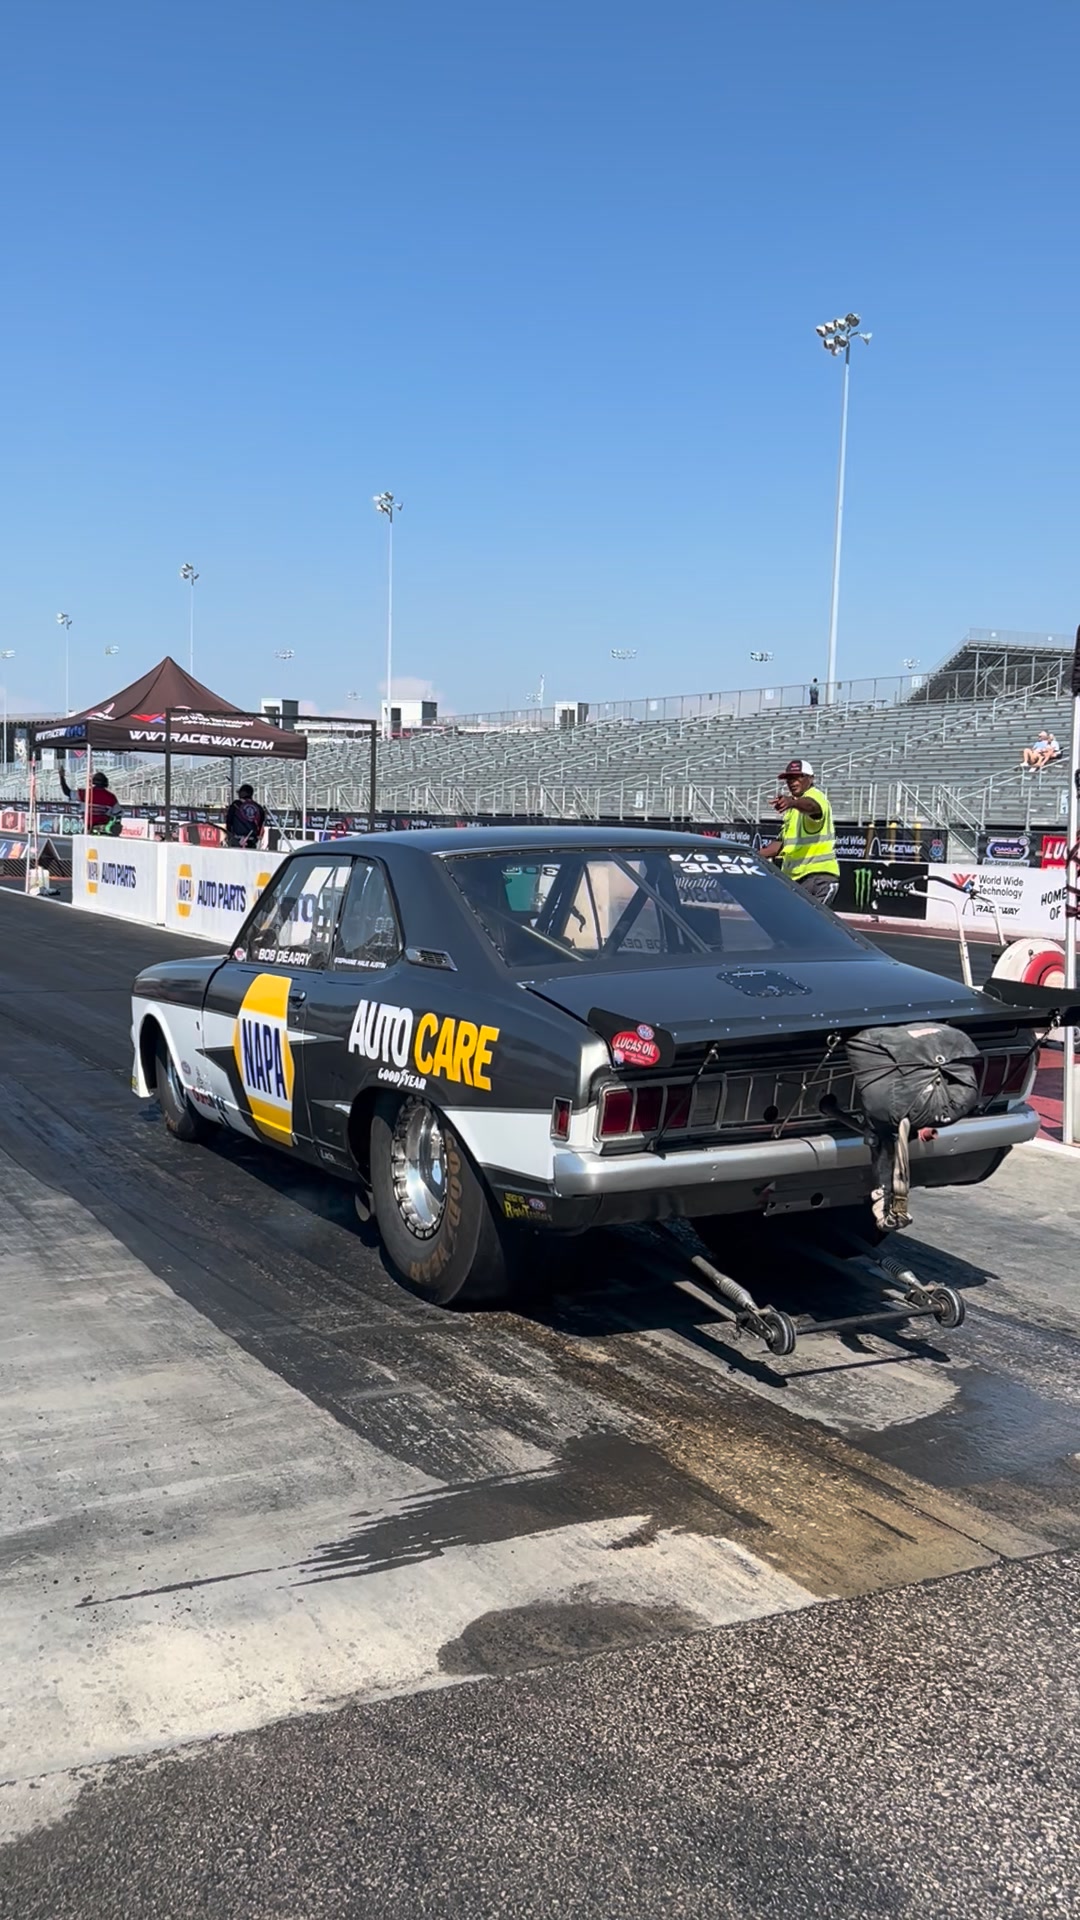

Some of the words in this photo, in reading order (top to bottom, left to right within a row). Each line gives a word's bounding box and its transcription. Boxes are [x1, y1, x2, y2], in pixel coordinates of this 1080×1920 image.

[850, 836, 866, 845] Wide
[881, 844, 922, 854] RACEWAY
[101, 861, 116, 886] AUTO
[117, 863, 136, 888] PARTS
[680, 863, 767, 876] 303K
[178, 878, 194, 902] NAPA
[979, 875, 1001, 885] World
[1003, 876, 1024, 887] Wide
[197, 879, 217, 906] AUTO
[218, 882, 246, 912] PARTS
[979, 886, 1023, 899] Technology
[1041, 888, 1067, 905] HOME
[1050, 906, 1061, 920] OF
[258, 948, 275, 960] BOB
[277, 950, 311, 966] DEARRY
[348, 999, 413, 1068] AUTO
[414, 1012, 500, 1091] CARE
[616, 1037, 641, 1052] LUCAS
[642, 1044, 655, 1056] OIL
[242, 1018, 288, 1100] NAPA
[378, 1067, 427, 1090] GOODYEAR
